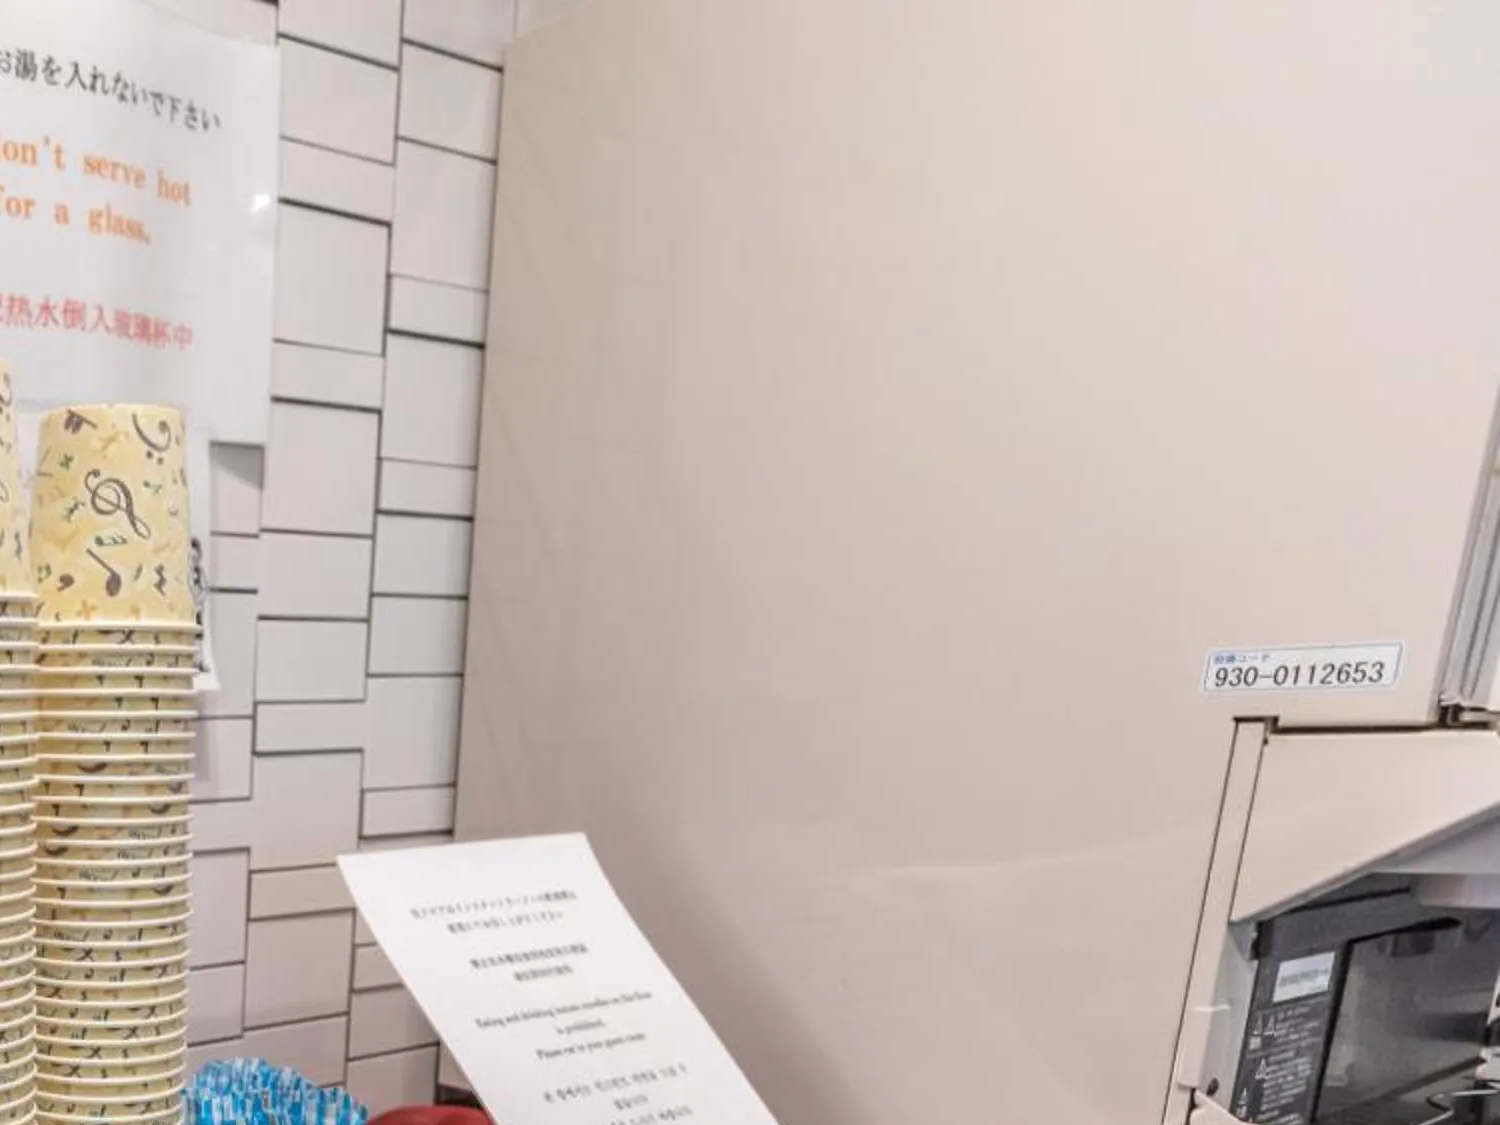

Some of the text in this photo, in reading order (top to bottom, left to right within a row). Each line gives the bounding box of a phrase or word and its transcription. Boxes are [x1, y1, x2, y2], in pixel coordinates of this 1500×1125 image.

[83, 154, 147, 190] serve
[157, 167, 192, 206] hot
[54, 203, 70, 225] a
[1214, 661, 1385, 687] 930-0112653
